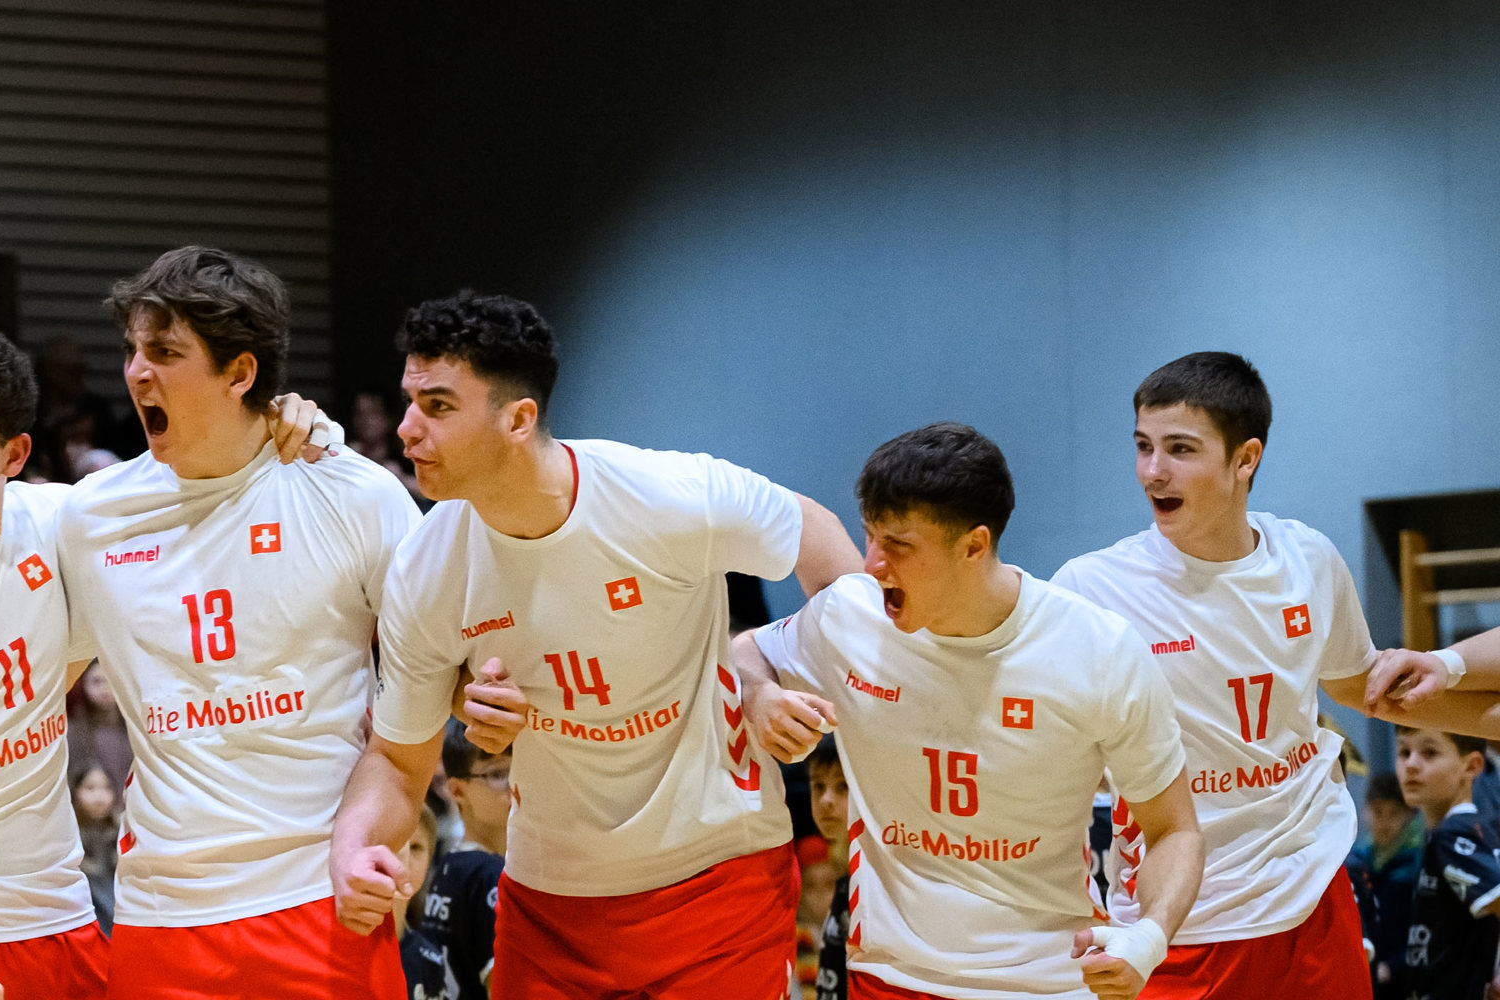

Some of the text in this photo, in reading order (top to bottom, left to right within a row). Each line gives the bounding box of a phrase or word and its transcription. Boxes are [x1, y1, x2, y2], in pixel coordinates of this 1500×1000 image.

[105, 545, 160, 567] hummel
[182, 588, 236, 664] 13
[544, 650, 611, 710] 14
[846, 669, 900, 702] hummel
[147, 690, 304, 734] die Mobiliar
[525, 700, 681, 742] ie Mobiliar
[1227, 672, 1273, 743] 17
[922, 747, 979, 817] 15
[1191, 770, 1232, 793] die
[882, 820, 1040, 861] die Mobiliar
